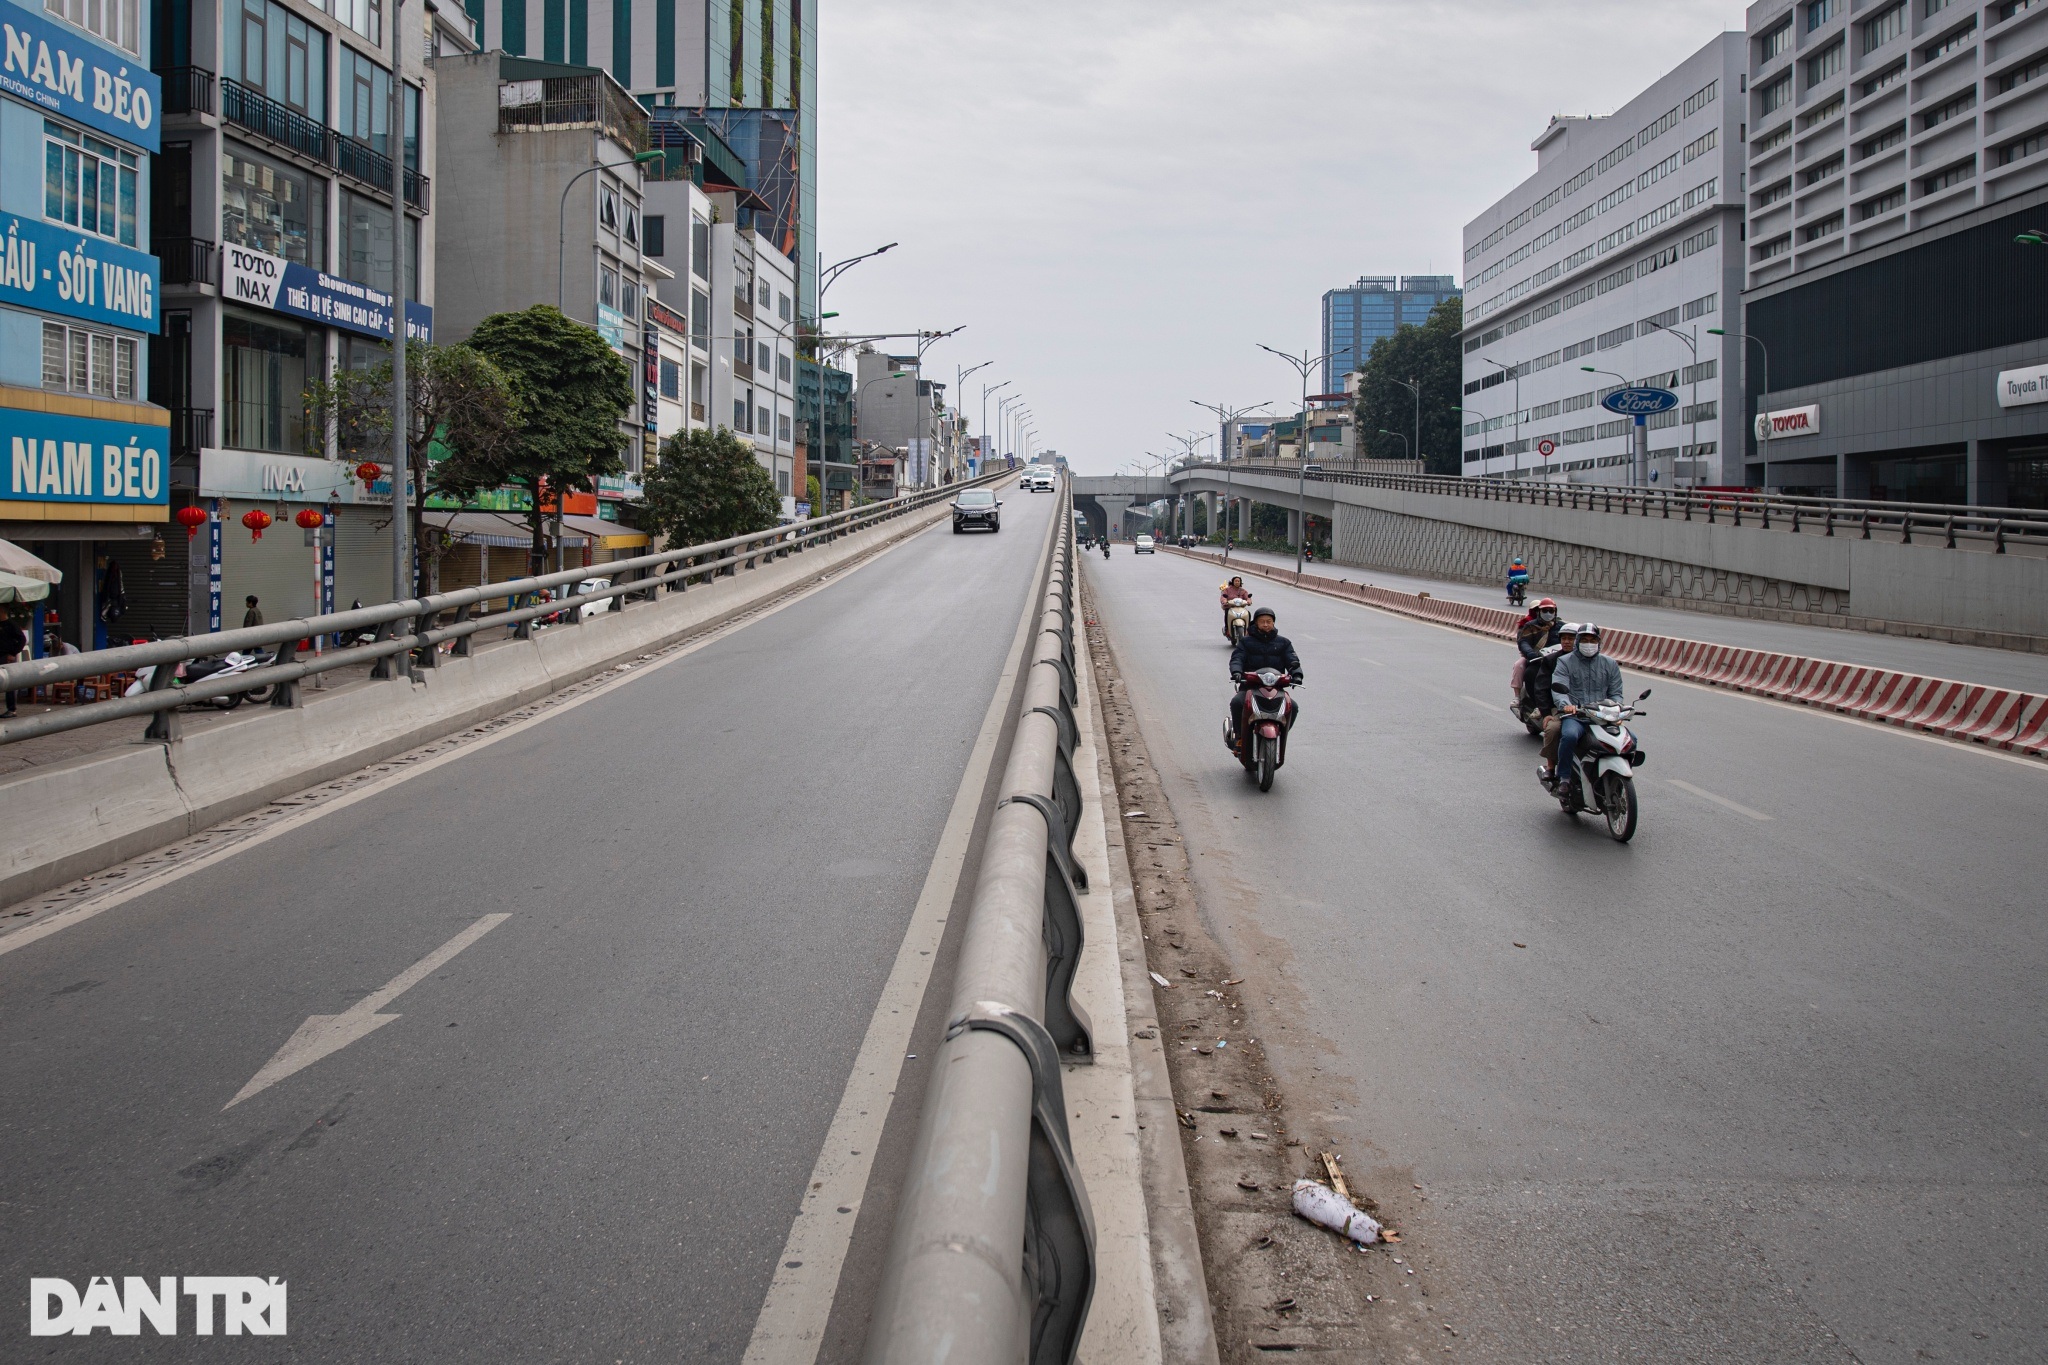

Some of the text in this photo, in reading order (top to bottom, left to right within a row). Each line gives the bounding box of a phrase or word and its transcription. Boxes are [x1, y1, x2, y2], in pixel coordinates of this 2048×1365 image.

[4, 23, 151, 130] NAM BÉO
[58, 238, 98, 306] SỐT
[102, 262, 152, 320] VANG
[236, 276, 271, 304] INAX
[318, 273, 364, 299] Showroom
[287, 286, 309, 311] THIẾT
[311, 294, 320, 317] BỊ
[322, 295, 332, 320] VỆ
[333, 301, 352, 323] SINH
[352, 306, 368, 327] CAO
[368, 308, 384, 331] CẤP
[1617, 391, 1663, 411] Ford
[2007, 380, 2037, 397] Toyota
[1772, 413, 1809, 432] TOYOTA
[1543, 444, 1551, 452] 60
[12, 436, 160, 499] NAM BÉO
[262, 464, 306, 492] INAX
